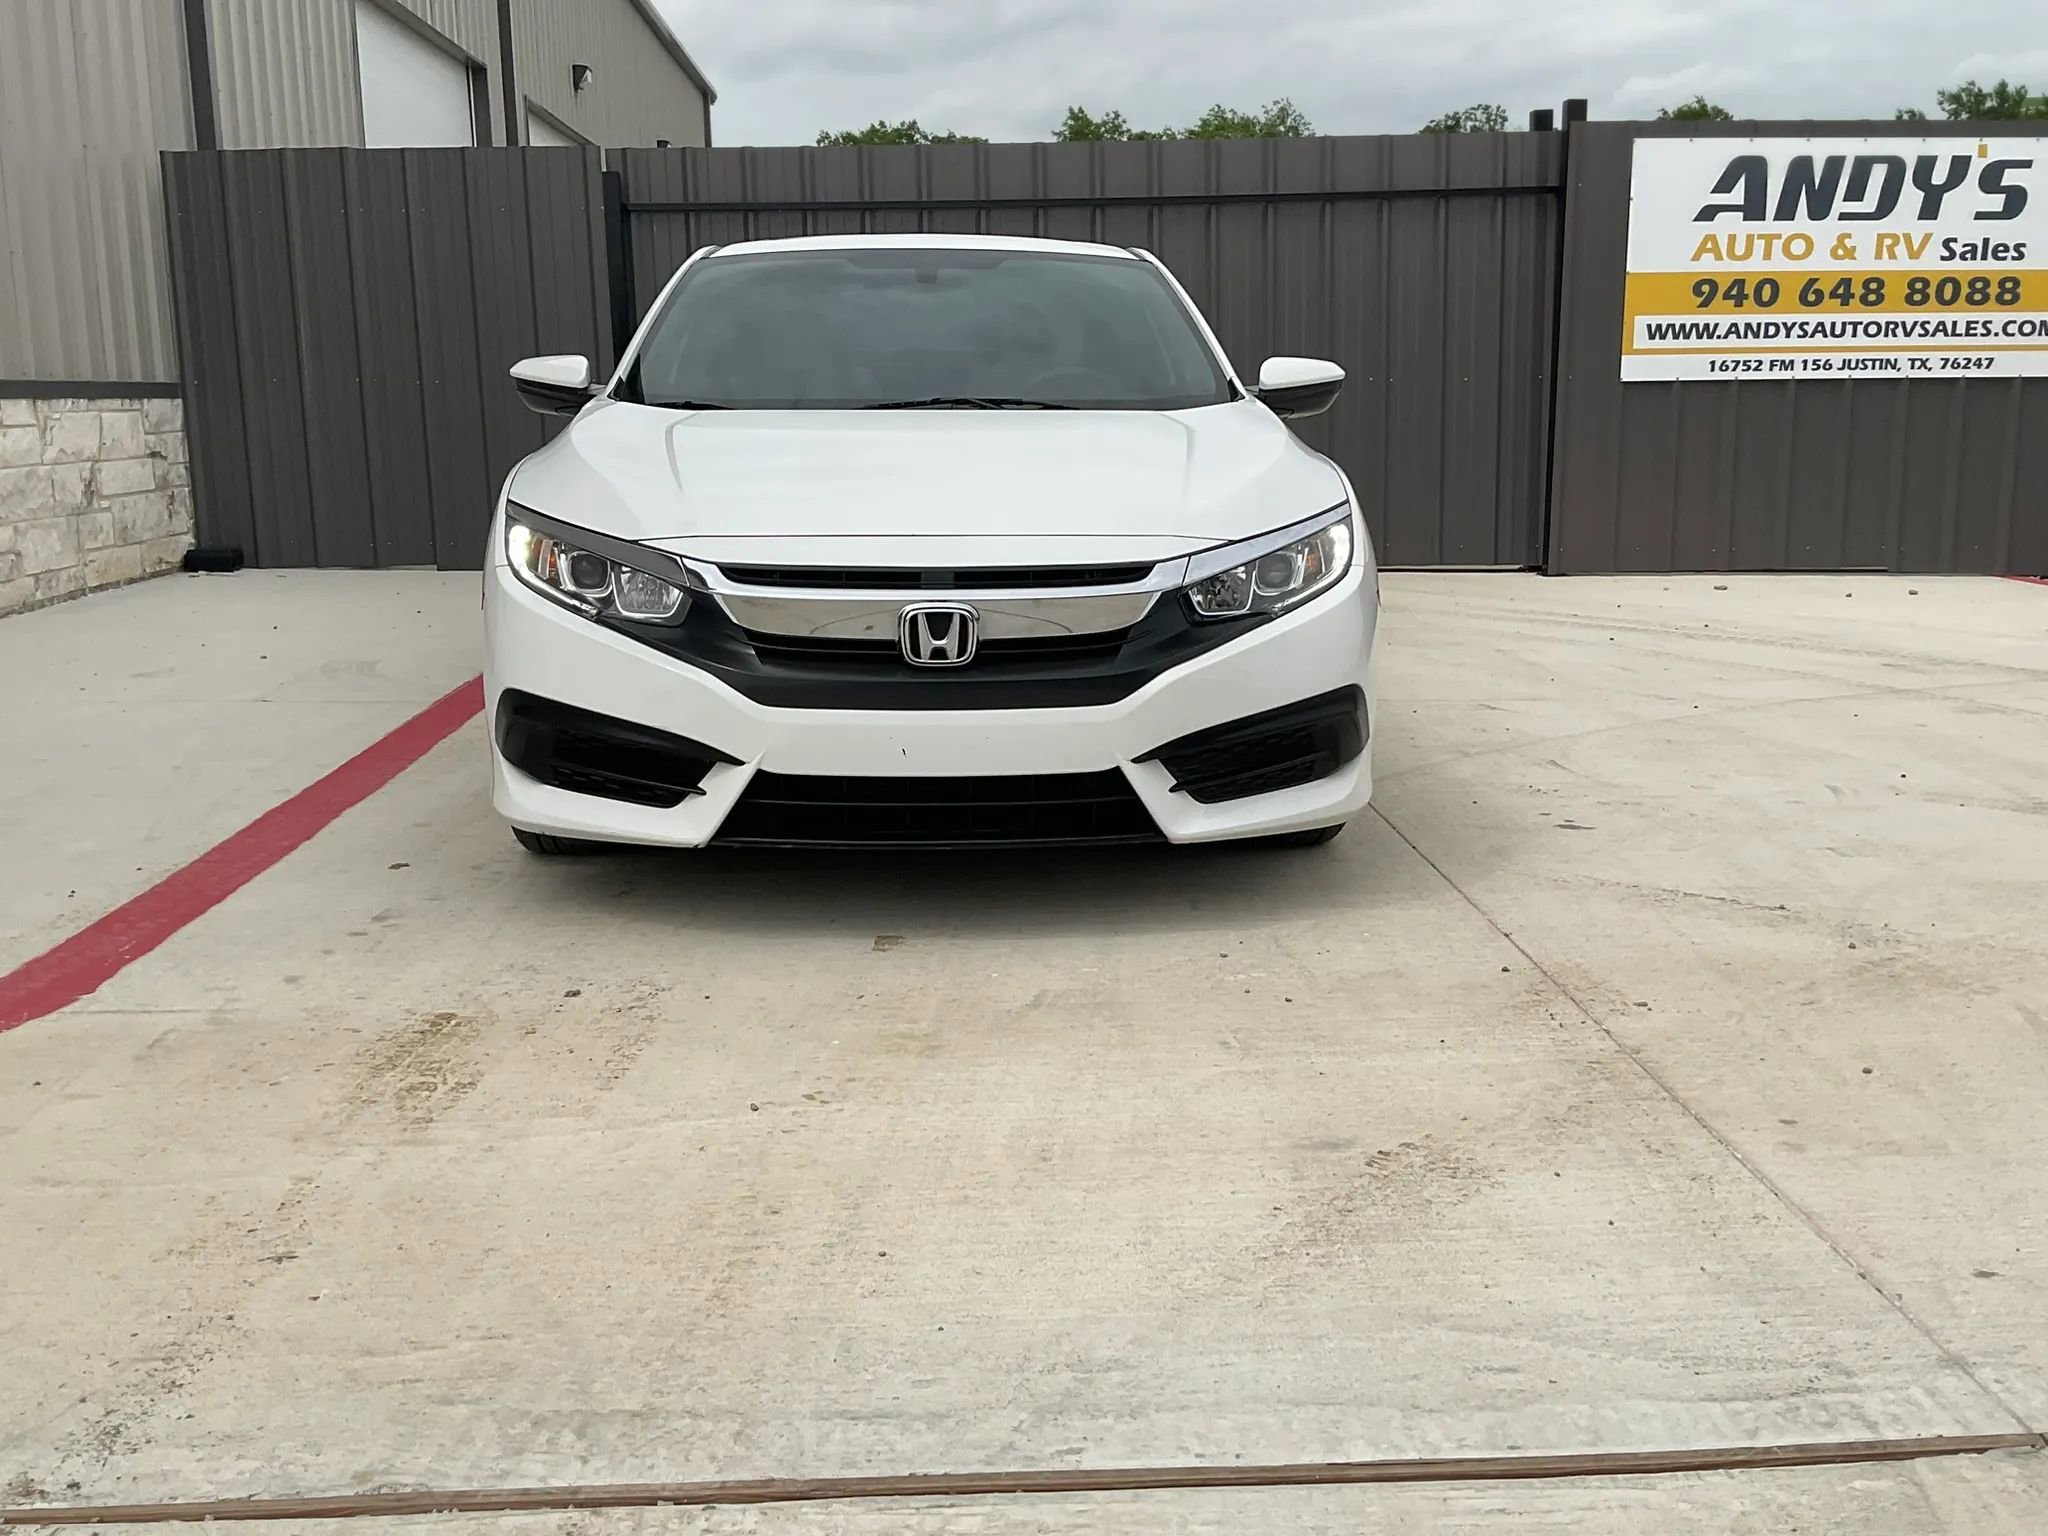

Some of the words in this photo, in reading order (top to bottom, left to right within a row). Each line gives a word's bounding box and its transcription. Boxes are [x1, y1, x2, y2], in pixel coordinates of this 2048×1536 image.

[1692, 143, 2034, 222] ANDY'S
[1690, 233, 1814, 261] AUTO
[1829, 232, 1857, 261] &
[1873, 232, 1933, 260] RV
[1940, 237, 2027, 262] Sales
[1692, 278, 1780, 308] 940
[1798, 277, 1886, 307] 648
[1904, 276, 2021, 306] 8088
[1708, 359, 1764, 373] 16752
[1768, 359, 1795, 372] FM
[1801, 359, 1833, 372] 156
[1837, 358, 1901, 372] JUSTIN,
[1906, 358, 1933, 372] TX,
[1939, 357, 1995, 371] 76247
